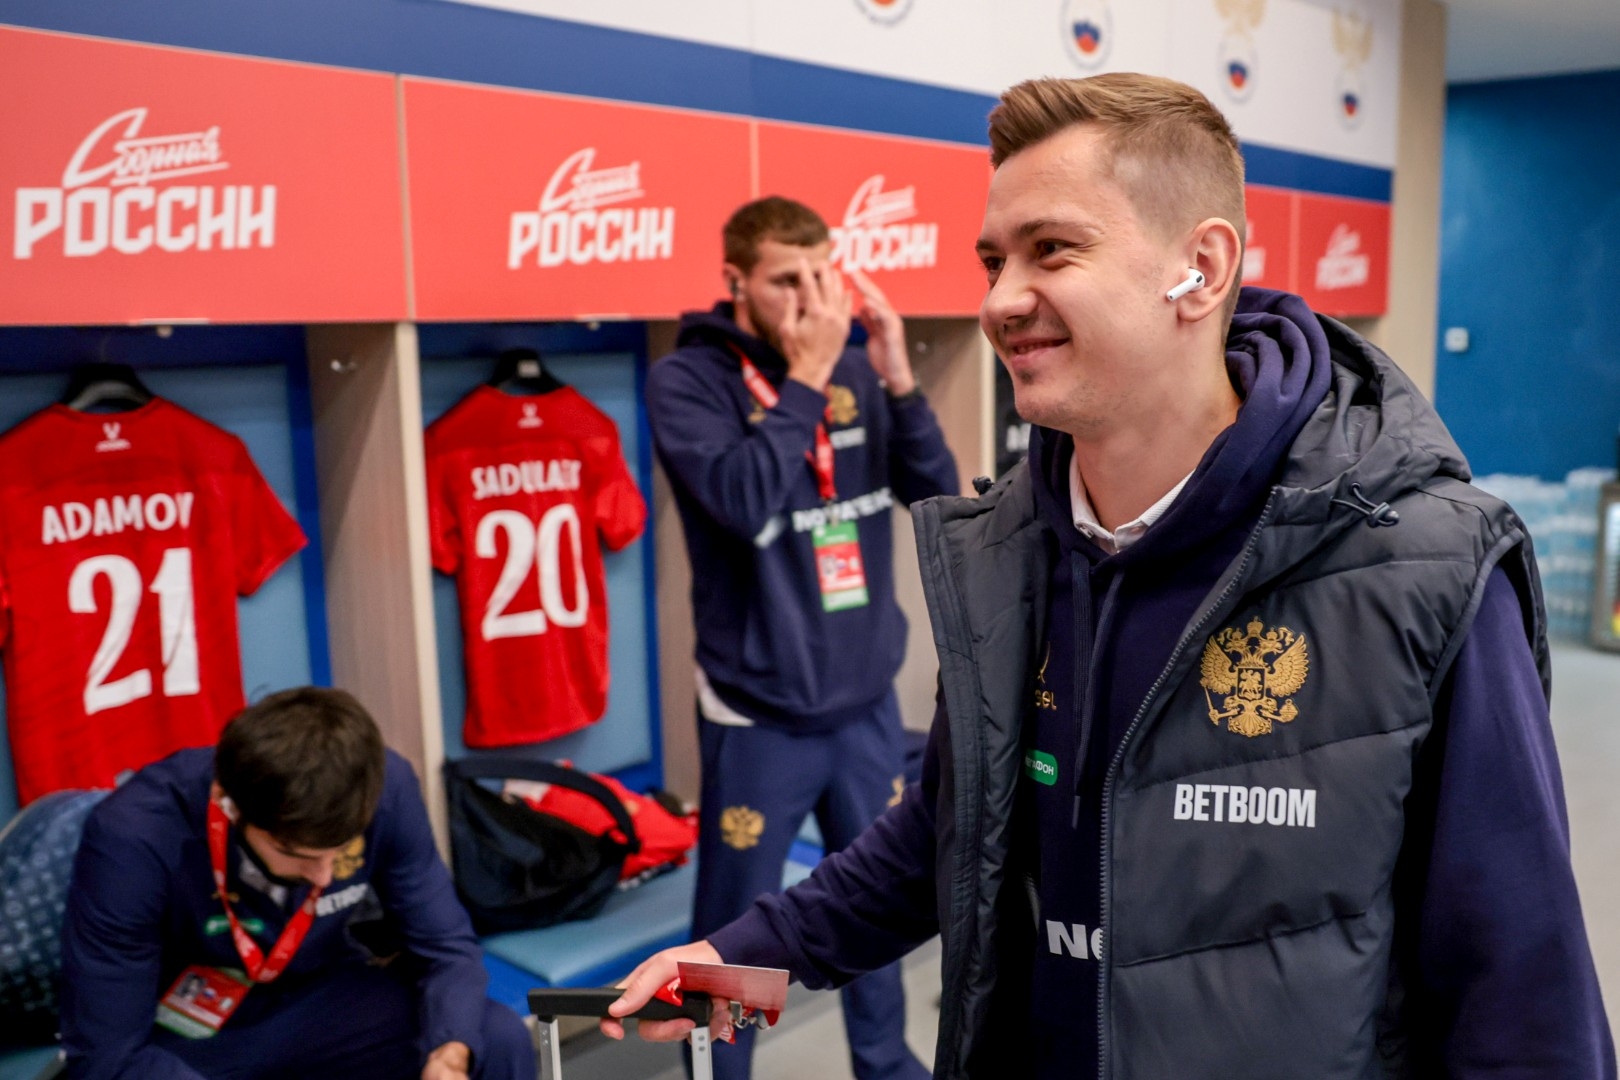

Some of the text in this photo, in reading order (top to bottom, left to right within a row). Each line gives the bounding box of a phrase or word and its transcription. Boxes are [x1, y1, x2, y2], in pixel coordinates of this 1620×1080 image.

[14, 185, 276, 259] РОССИИ
[508, 207, 675, 270] РОССИИ
[475, 503, 589, 641] 20
[68, 547, 200, 716] 21
[1025, 756, 1054, 776] ЕГАФОН
[1173, 783, 1317, 828] BETBOOM
